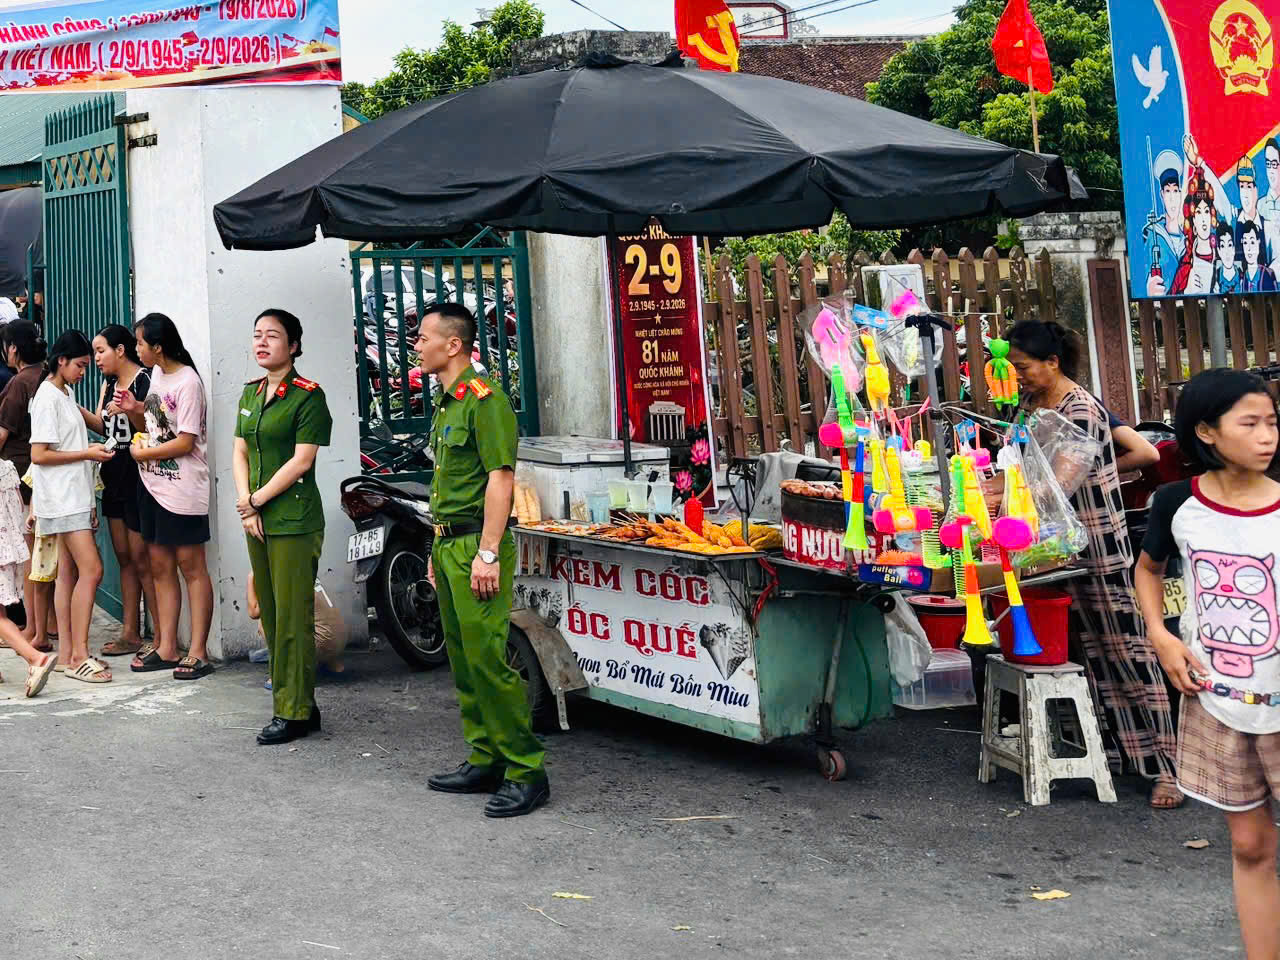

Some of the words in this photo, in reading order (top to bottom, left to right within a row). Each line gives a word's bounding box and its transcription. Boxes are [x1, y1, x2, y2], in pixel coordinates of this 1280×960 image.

[11, 43, 50, 77] VIỆT
[108, 39, 184, 70] 2/9/1945
[199, 35, 271, 65] 2/9/2026
[624, 243, 683, 296] 2-9
[628, 300, 656, 312] 2.9.1945
[642, 339, 659, 364] 81
[661, 348, 679, 363] NĂM
[639, 364, 658, 379] QUỐC
[660, 364, 684, 378] KHÁNH
[353, 529, 379, 547] 17-B5
[349, 541, 380, 561] 181.49
[550, 555, 623, 592] KEM
[634, 566, 711, 606] CỐC
[883, 574, 903, 584] Ball
[568, 600, 612, 641] ỐC
[622, 622, 698, 659] QUẾ
[670, 673, 703, 697] Bốn
[707, 681, 751, 708] Mùa
